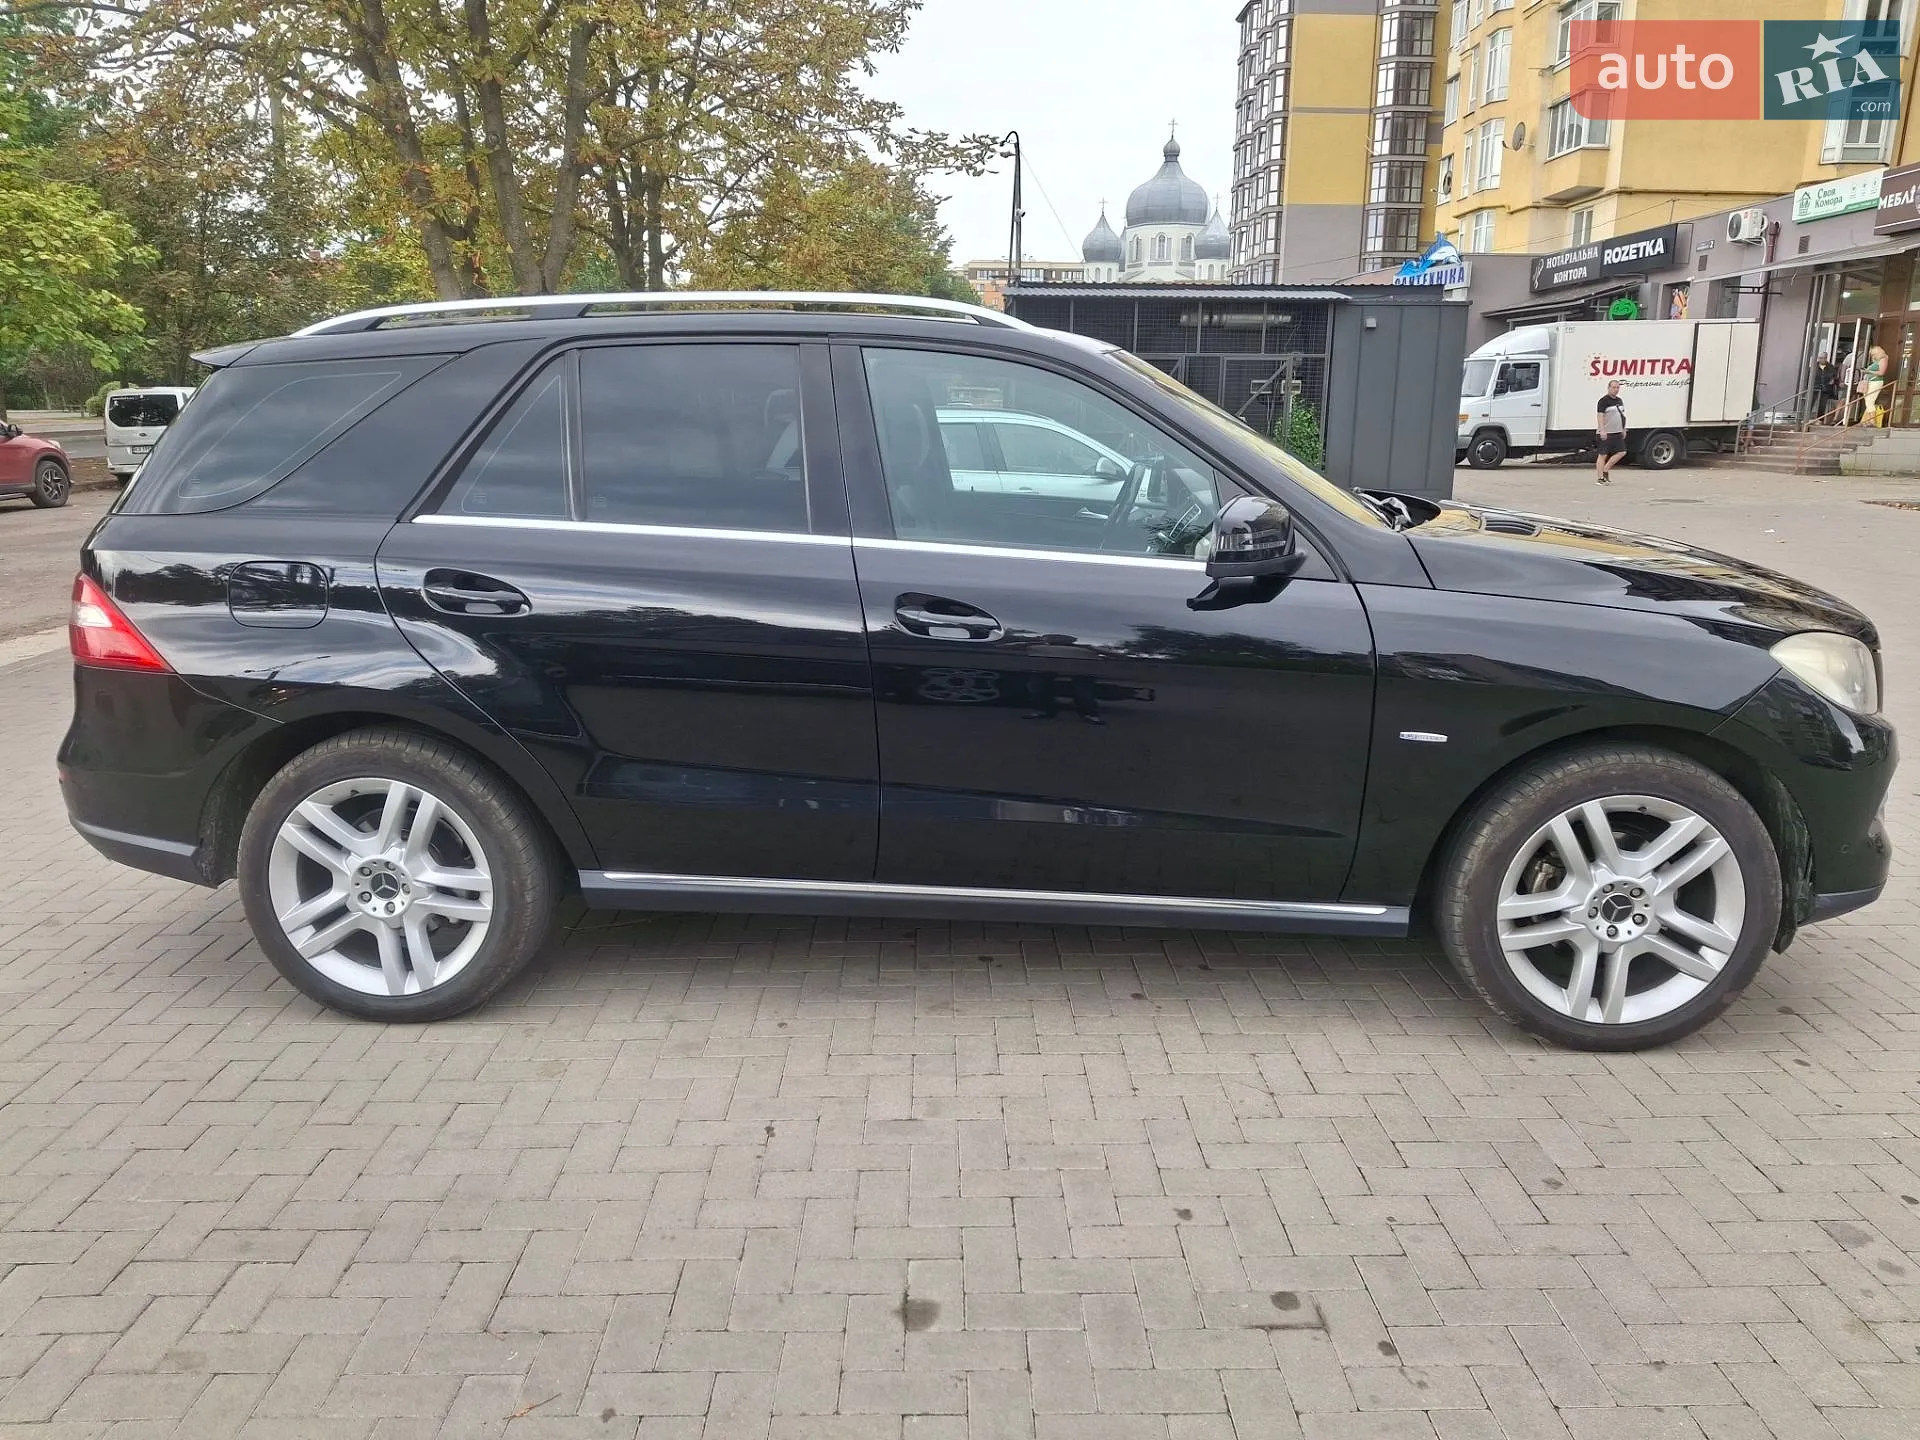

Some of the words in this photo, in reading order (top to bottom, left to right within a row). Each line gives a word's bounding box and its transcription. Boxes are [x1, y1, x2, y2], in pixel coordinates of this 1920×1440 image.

[1814, 195, 1843, 209] Комора
[1817, 187, 1836, 199] Своя
[1879, 185, 1916, 210] МЕБЛІ
[1546, 245, 1599, 269] НОТАРІАЛЬНА
[1603, 237, 1665, 265] ROZETKA
[1553, 266, 1587, 284] КОНТОРА
[1590, 356, 1692, 377] ŠUMITRA
